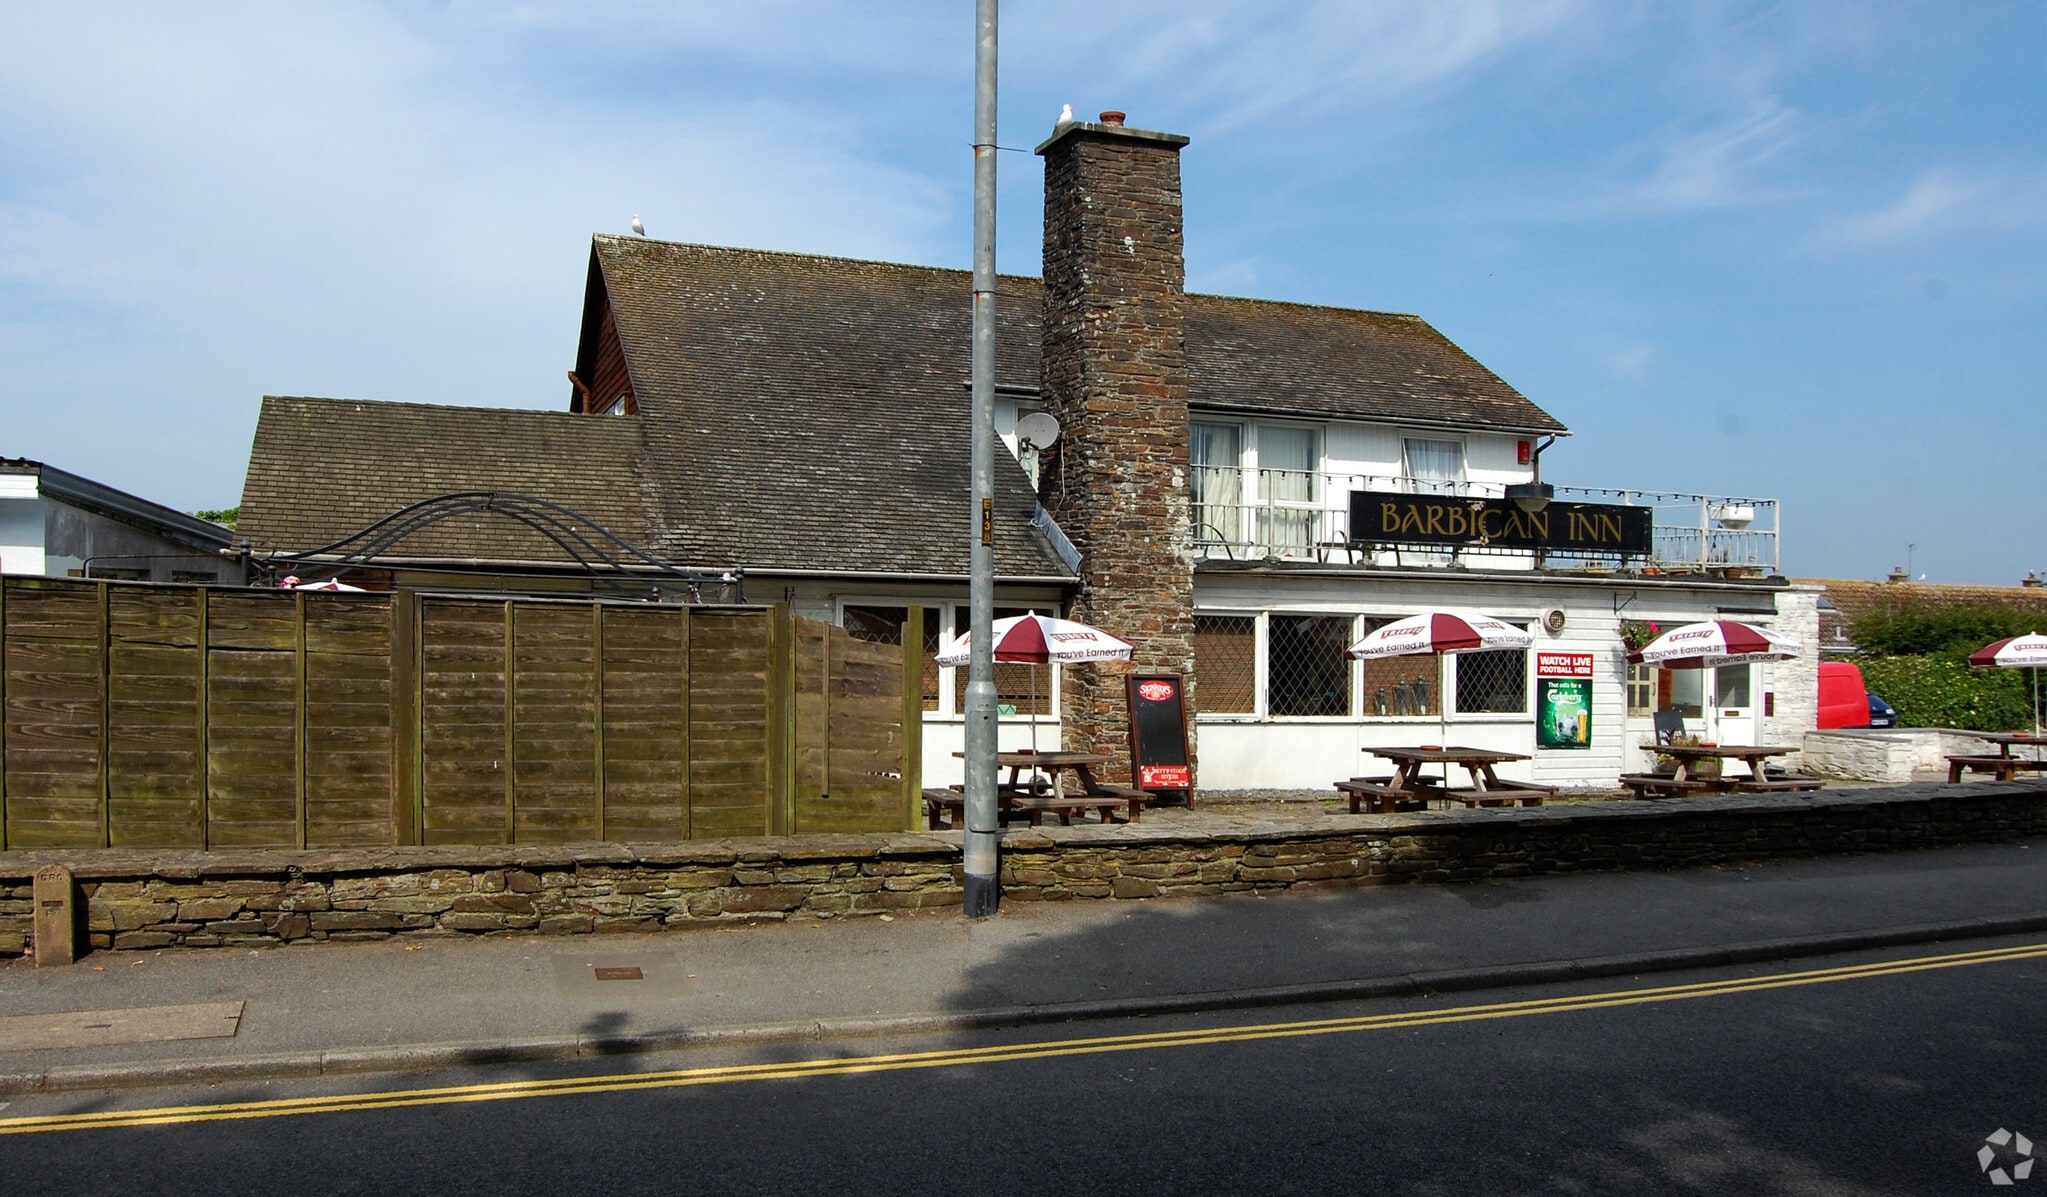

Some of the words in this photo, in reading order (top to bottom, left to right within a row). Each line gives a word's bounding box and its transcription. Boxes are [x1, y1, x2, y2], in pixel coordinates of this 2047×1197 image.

[1381, 502, 1550, 539] BARBICAN
[1567, 511, 1623, 543] INN
[1386, 642, 1417, 652] Earned
[1650, 649, 1678, 659] You've
[1680, 645, 1712, 655] Earned
[1086, 648, 1117, 657] Earned
[1540, 656, 1571, 665] WATCH
[1573, 656, 1592, 666] LIVE
[1540, 665, 1573, 674] FOOTBALL
